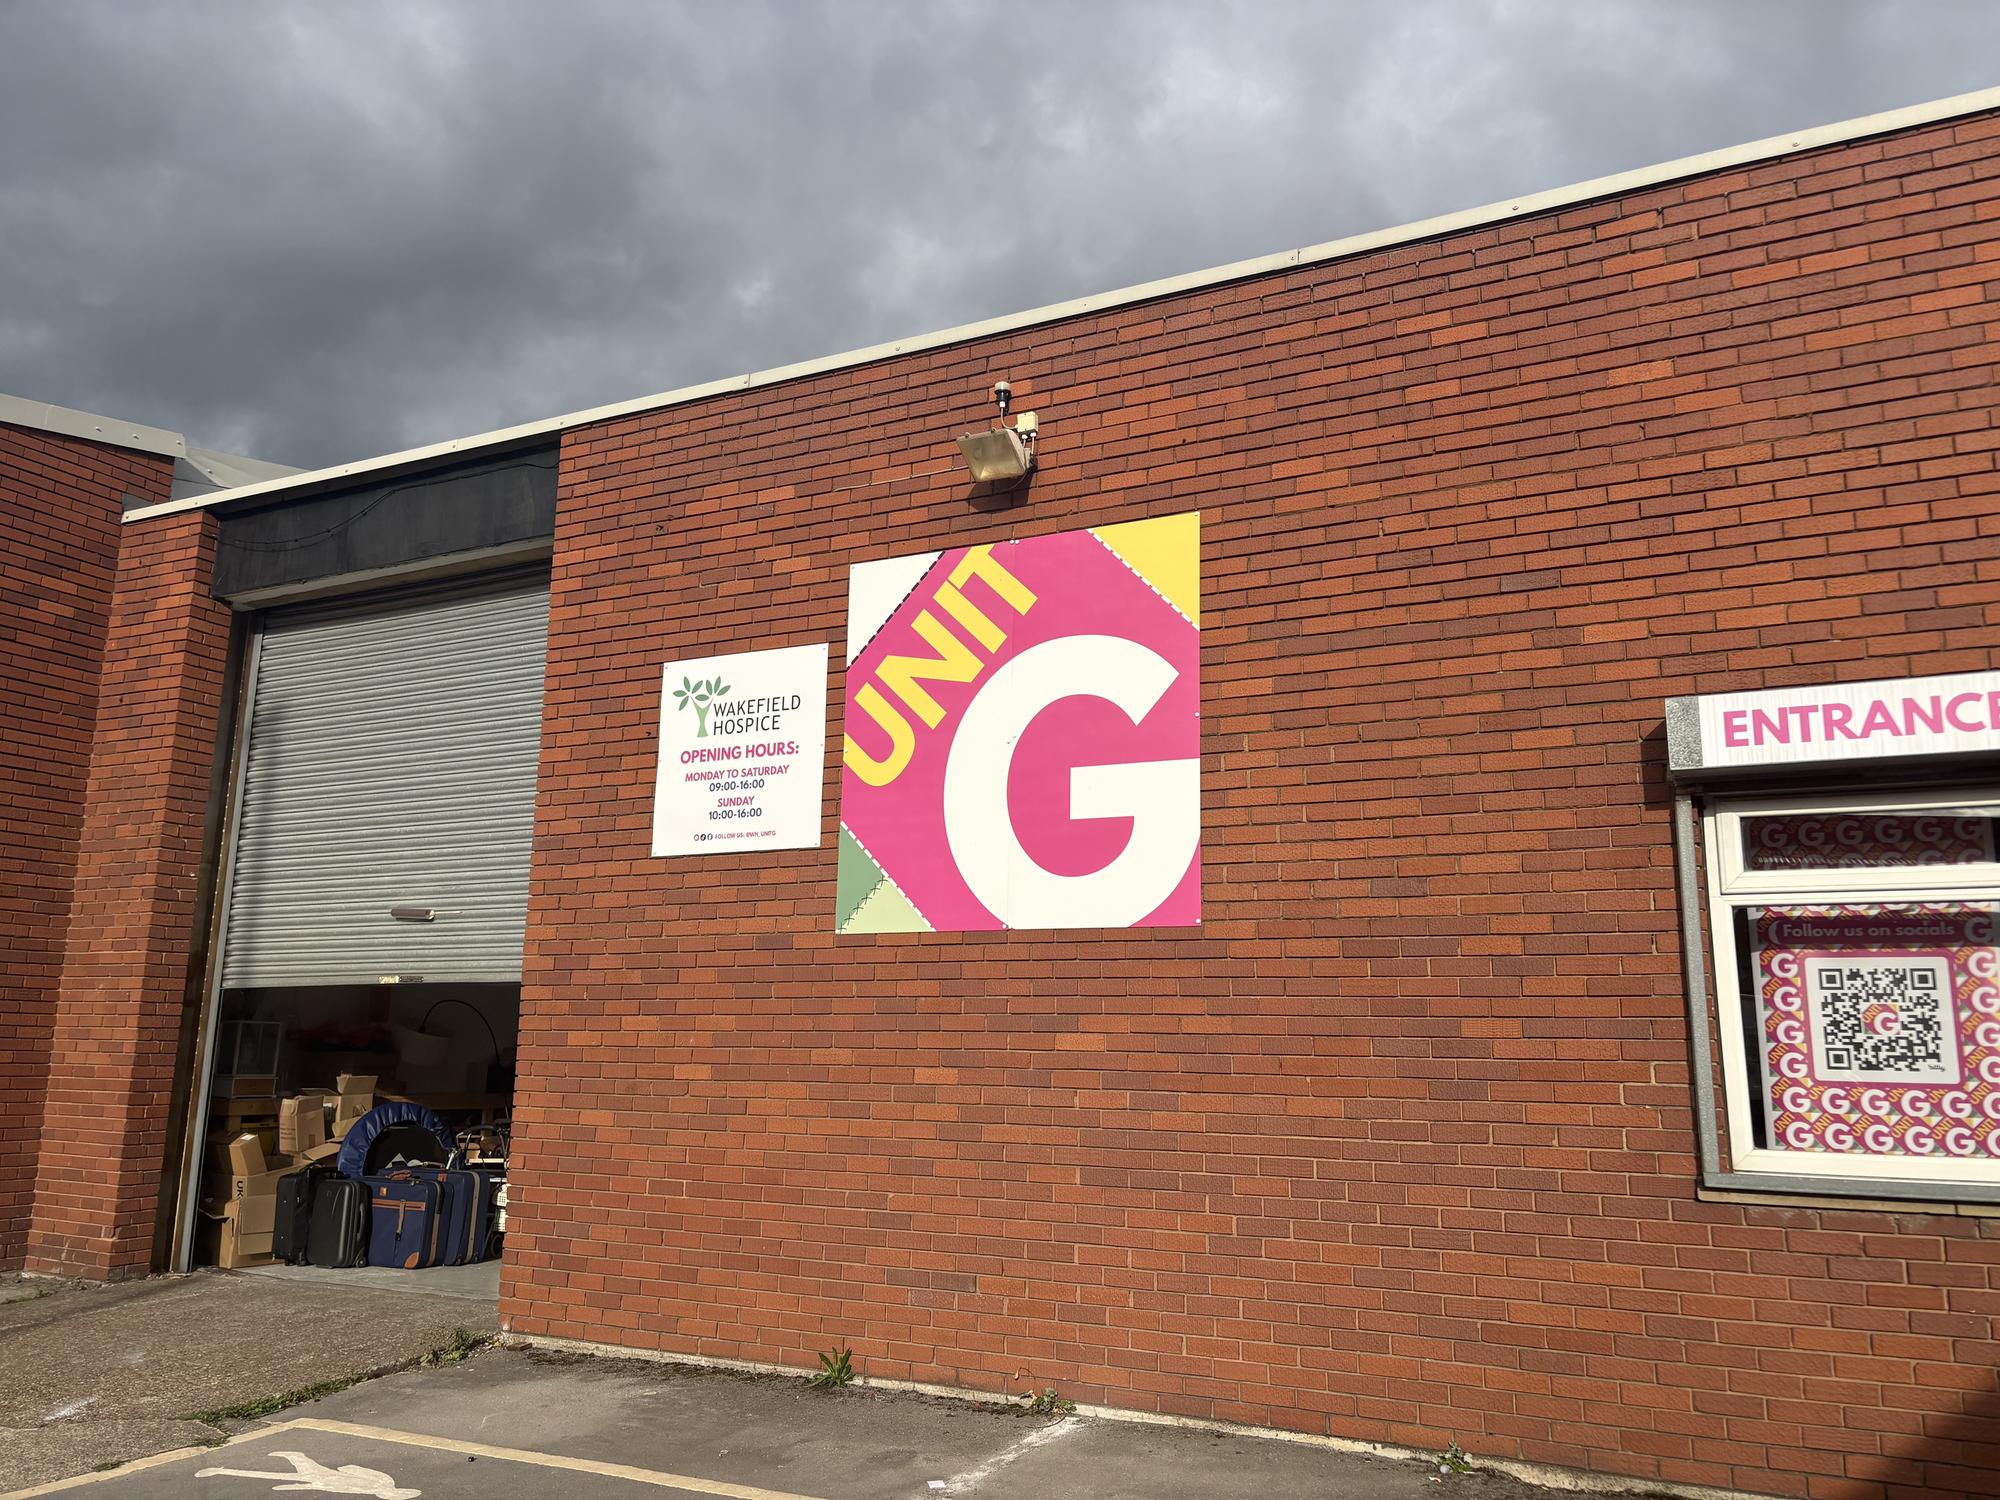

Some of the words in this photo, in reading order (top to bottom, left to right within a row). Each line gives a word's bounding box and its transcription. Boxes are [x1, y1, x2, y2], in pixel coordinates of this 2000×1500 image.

[843, 544, 1038, 787] UNIT
[714, 695, 801, 717] WAKEFIELD
[714, 715, 781, 736] HOSPICE
[680, 746, 742, 764] OPENING
[745, 741, 799, 758] HOURS:
[685, 770, 725, 782] MONDAY
[727, 769, 739, 779] TO
[741, 765, 790, 777] SATURDAY
[709, 779, 765, 792] 09:00-16:00
[944, 634, 1200, 930] G
[709, 807, 763, 820] 10:00-16:00
[717, 796, 755, 807] SUNDAY
[1761, 823, 1788, 848] G
[1798, 822, 1825, 846] G
[1836, 820, 1864, 845] G
[1874, 818, 1903, 843] G
[1913, 816, 1943, 842] G
[1954, 817, 1984, 840] G
[1783, 923, 1840, 937] Follow
[1844, 927, 1864, 937] us
[1867, 927, 1890, 936] on
[1896, 921, 1955, 936] socials
[1965, 917, 1993, 943] G
[1771, 953, 1799, 978] G
[1967, 951, 1997, 977] G
[1773, 986, 1801, 1011] G
[1971, 987, 2000, 1013] G
[1776, 1020, 1805, 1044] G
[1874, 1012, 1900, 1035] G
[1975, 1022, 2000, 1048] G
[1780, 1052, 1808, 1078] G
[1783, 1086, 1811, 1113] G
[1821, 1088, 1850, 1114] G
[1861, 1089, 1890, 1116] G
[1901, 1090, 1931, 1117] G
[1942, 1091, 1972, 1118] G
[1786, 1121, 1815, 1148] G
[1825, 1123, 1854, 1149] G
[1864, 1124, 1894, 1152] G
[1905, 1126, 1935, 1153] G
[1946, 1127, 1976, 1155] G
[236, 1180, 244, 1198] UK
